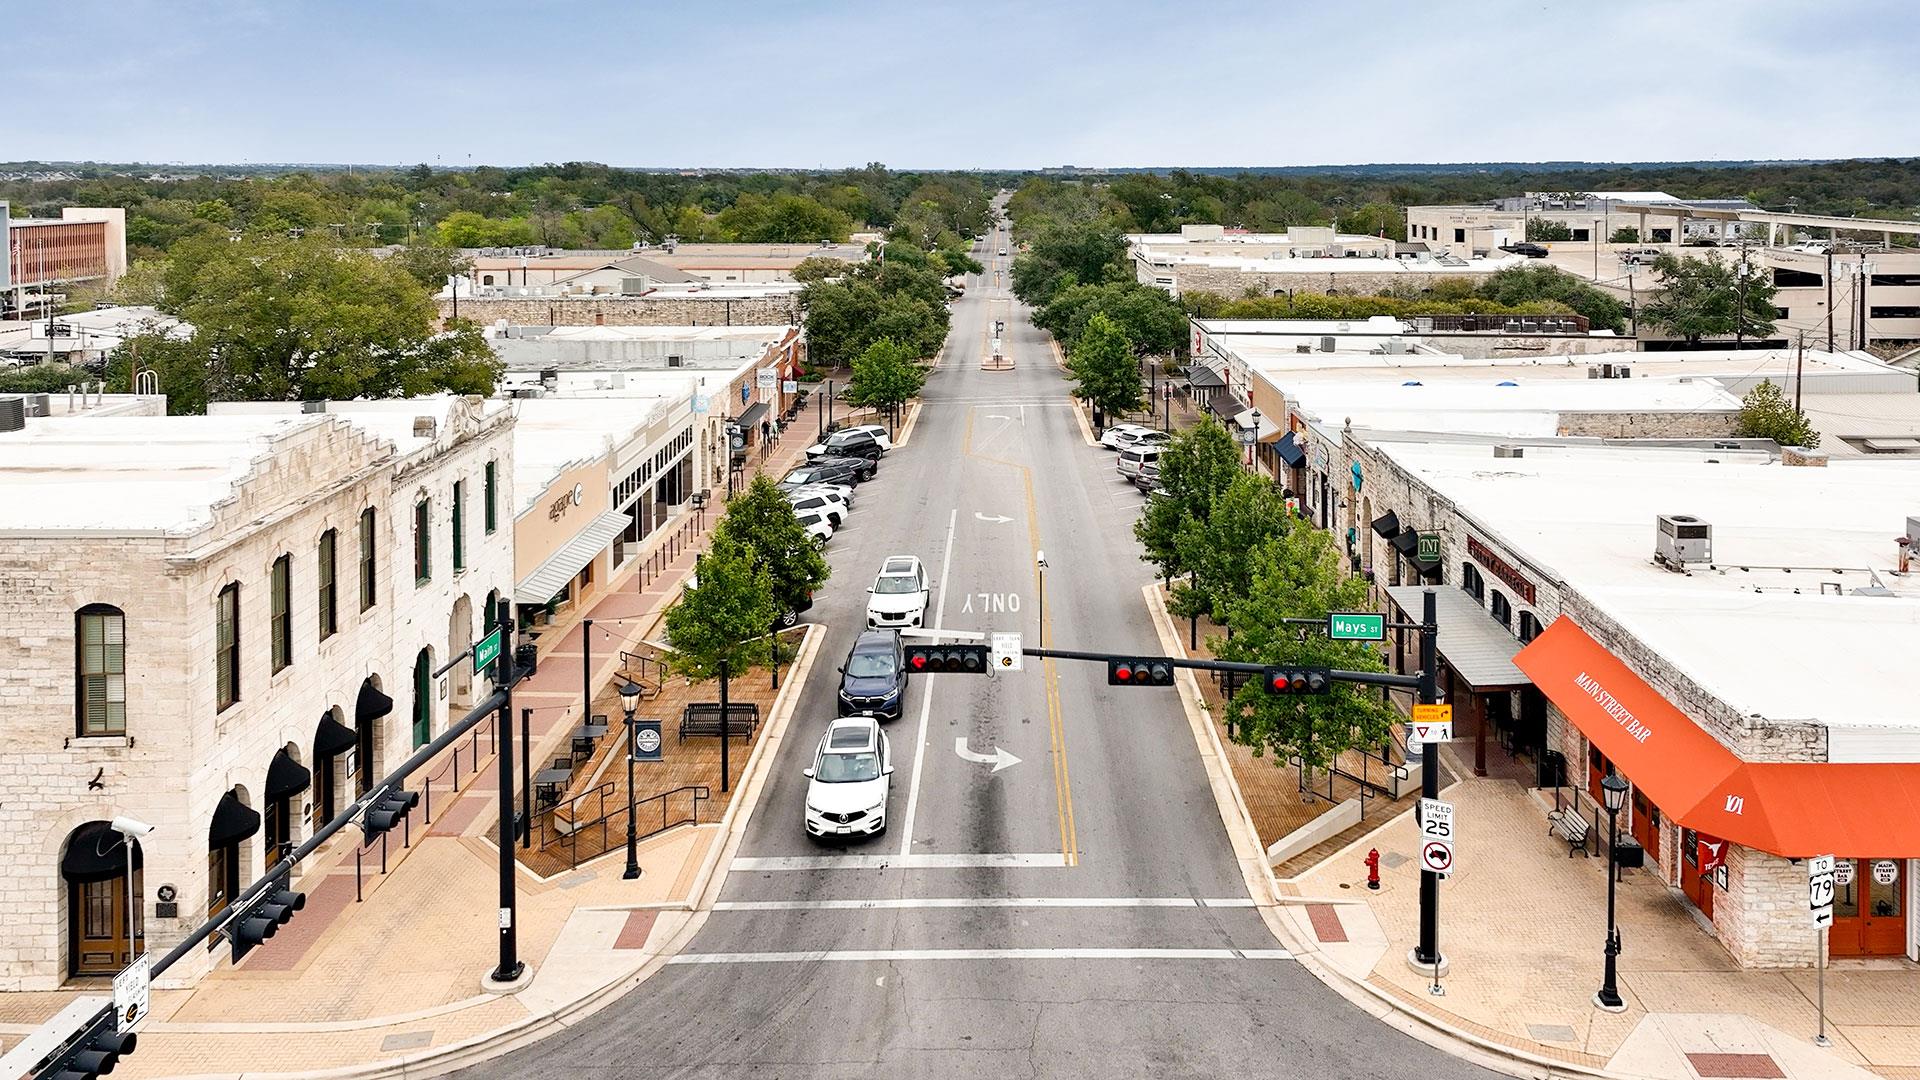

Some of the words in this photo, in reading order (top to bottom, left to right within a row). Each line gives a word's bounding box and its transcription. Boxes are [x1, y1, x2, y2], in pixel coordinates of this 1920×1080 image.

[549, 490, 573, 522] agape
[1420, 539, 1439, 552] TNT
[961, 593, 1020, 613] ONLY
[1335, 620, 1367, 634] Mays
[479, 645, 493, 663] Main
[1574, 671, 1602, 697] MAIN
[1595, 690, 1634, 726] STREET
[1625, 719, 1652, 743] BAR
[1424, 803, 1452, 814] SPEED
[1724, 794, 1744, 815] 101
[1427, 812, 1448, 821] LIMIT
[1425, 820, 1450, 837] 25
[1816, 860, 1828, 870] TO
[1812, 880, 1832, 900] 79
